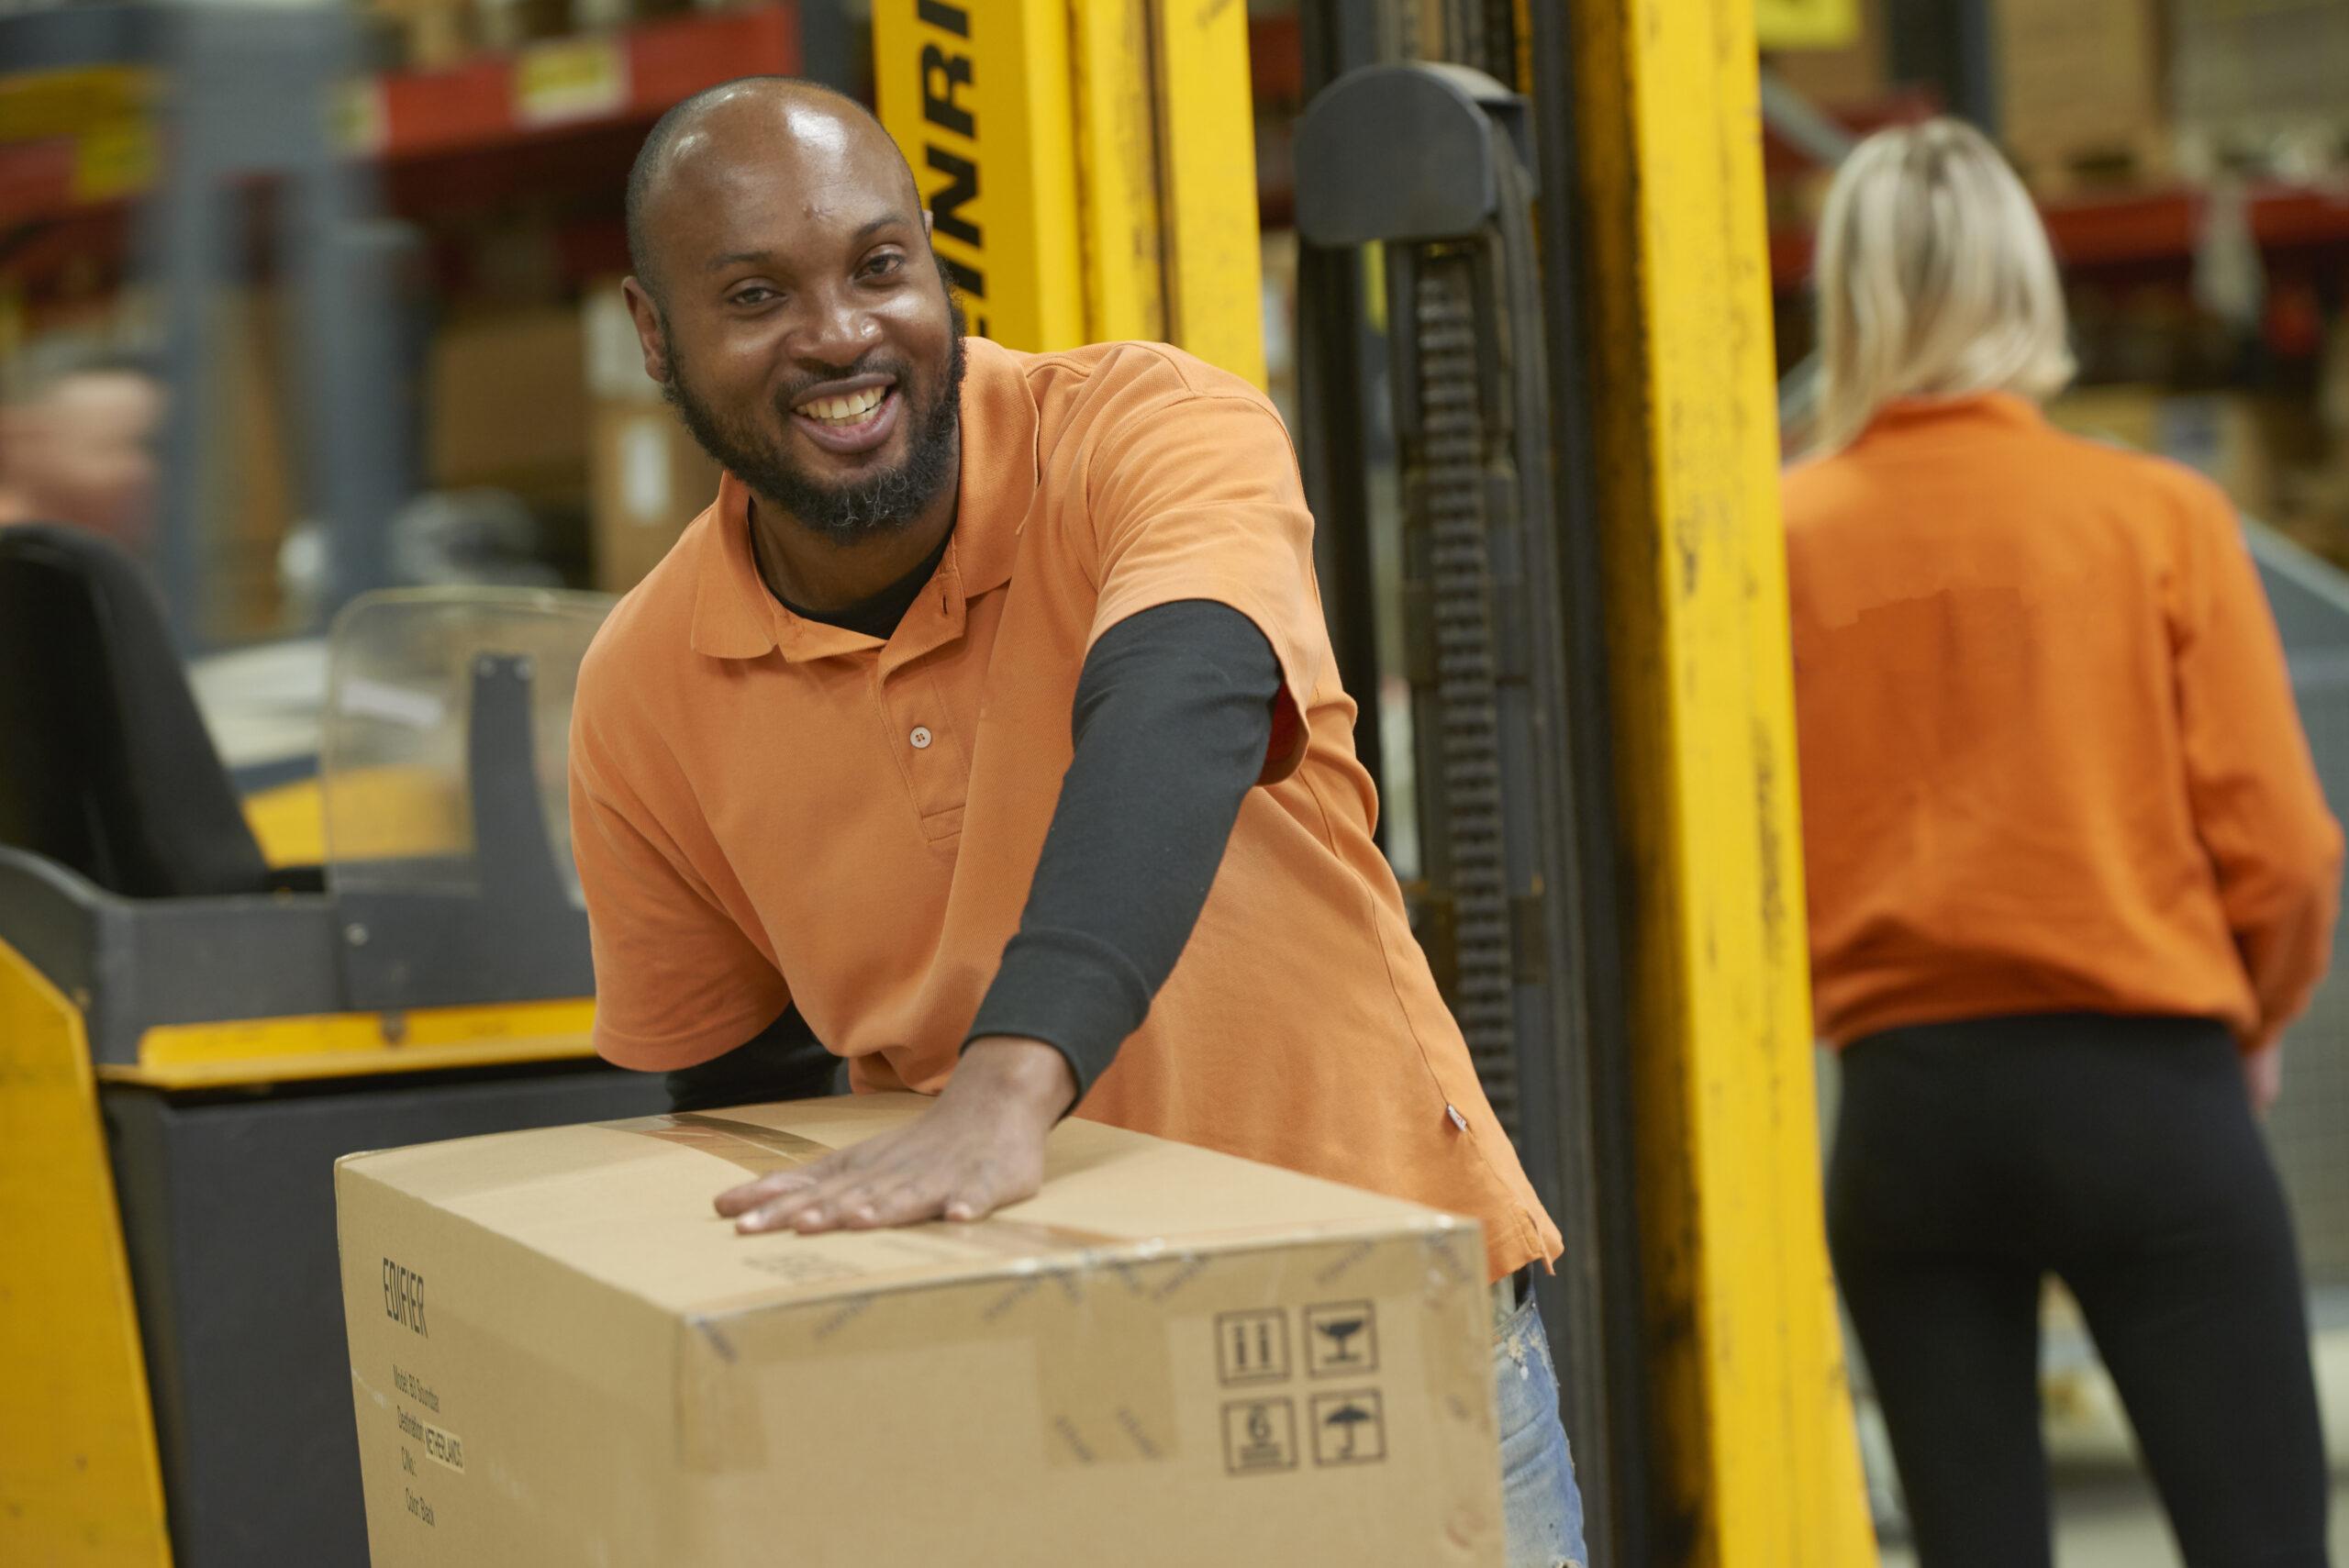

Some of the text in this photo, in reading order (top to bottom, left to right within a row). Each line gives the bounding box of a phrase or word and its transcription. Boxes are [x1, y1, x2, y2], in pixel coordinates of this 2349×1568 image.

[917, 0, 986, 337] INRI
[383, 1256, 429, 1339] EDIFIER
[425, 1426, 463, 1468] NETHERLANDS
[419, 1496, 436, 1528] Black
